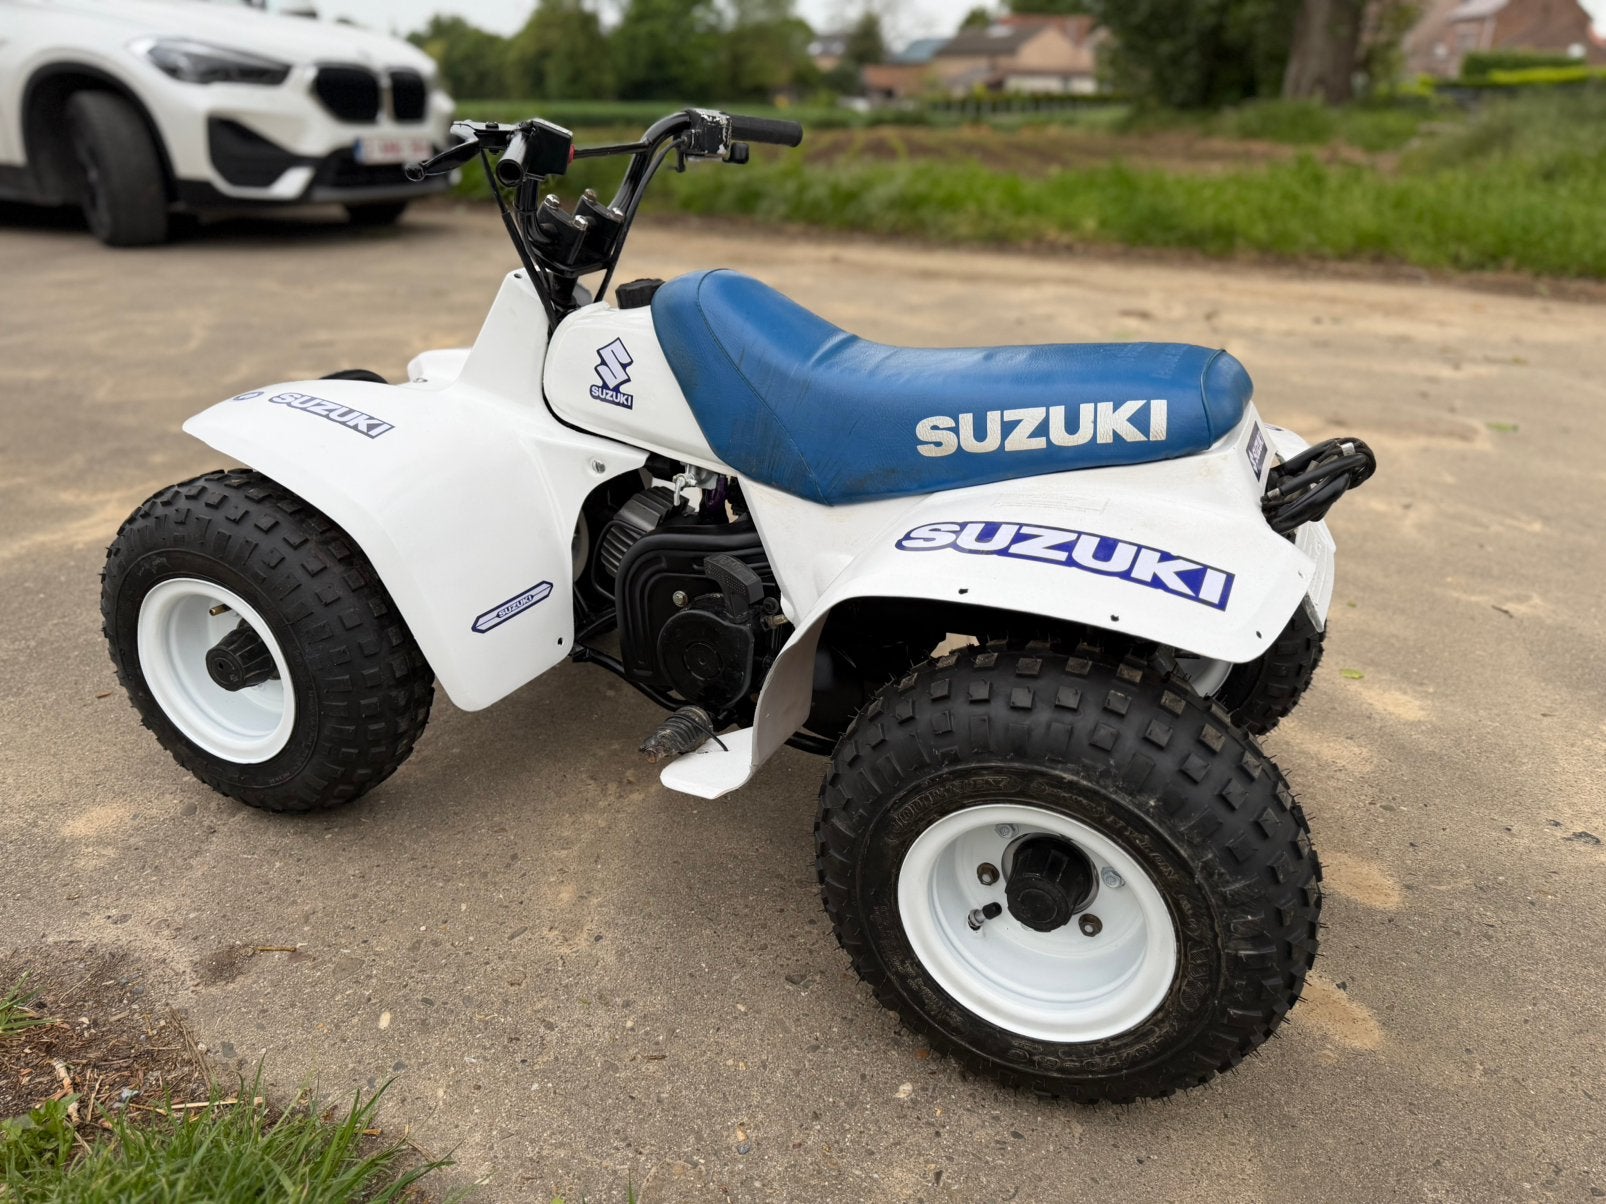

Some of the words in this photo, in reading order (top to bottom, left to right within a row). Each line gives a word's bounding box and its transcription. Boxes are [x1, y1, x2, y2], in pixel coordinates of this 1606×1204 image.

[270, 393, 393, 437] SUZUKI
[591, 385, 632, 406] SUZUKI
[916, 400, 1167, 457] SUZUKI
[901, 522, 1228, 605] SUZUKI
[498, 594, 533, 618] SUZUKI
